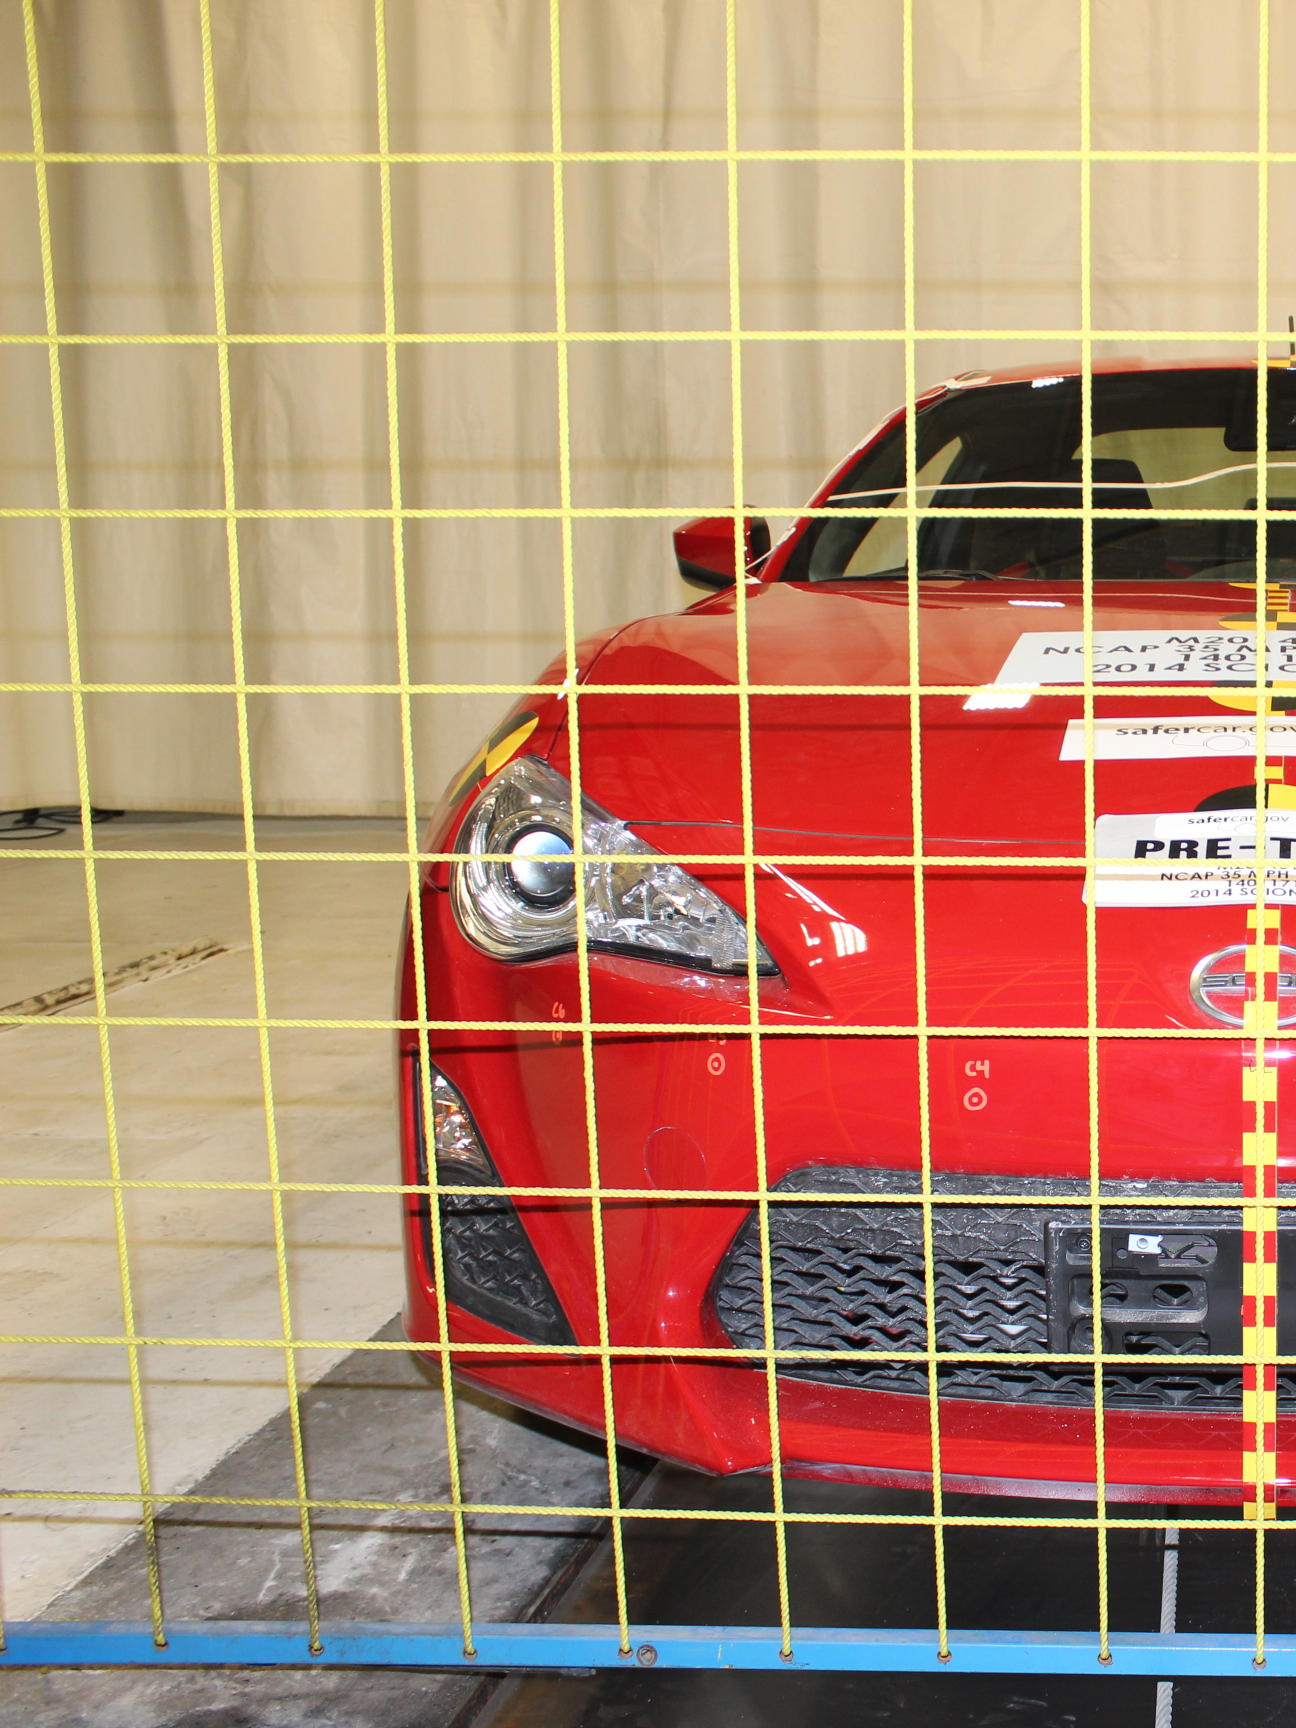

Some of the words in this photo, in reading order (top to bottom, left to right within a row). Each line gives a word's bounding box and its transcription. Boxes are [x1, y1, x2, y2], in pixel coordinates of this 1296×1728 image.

[1042, 644, 1160, 655] NCAP
[1174, 644, 1220, 653] 35
[1092, 663, 1187, 673] 2014
[1187, 815, 1290, 825] safercarov
[1160, 871, 1214, 881] NCAP
[1220, 870, 1242, 880] 35
[1190, 888, 1233, 899] 2014
[964, 1059, 990, 1079] C4
